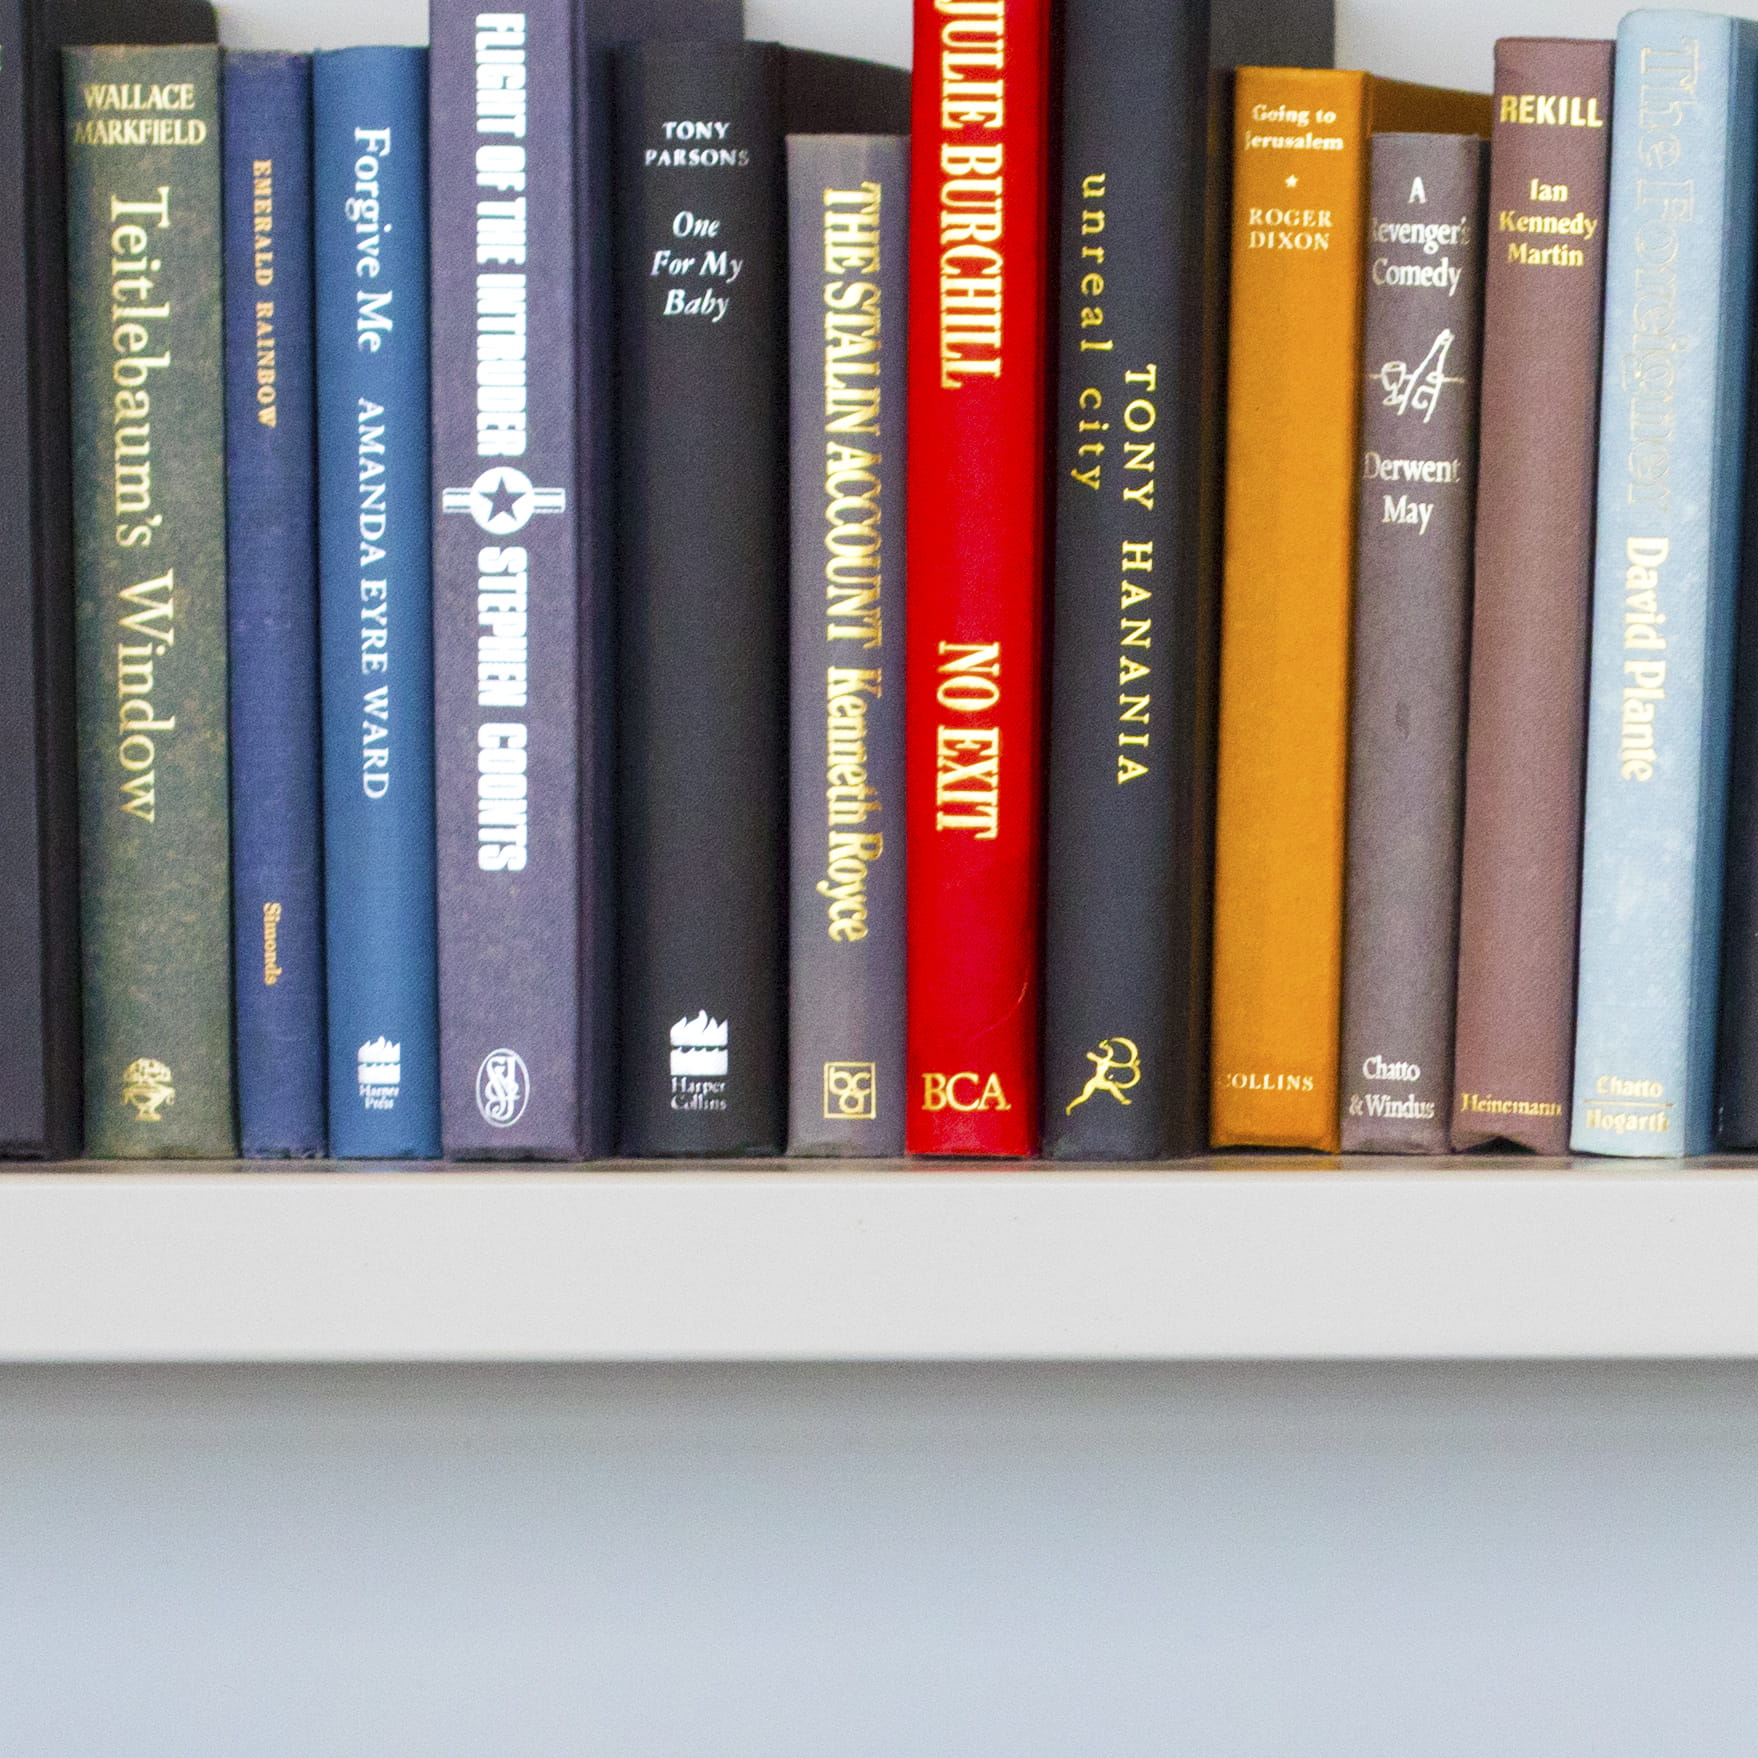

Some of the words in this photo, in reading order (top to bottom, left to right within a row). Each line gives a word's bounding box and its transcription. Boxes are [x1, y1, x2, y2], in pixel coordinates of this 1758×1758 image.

[75, 119, 206, 146] MARKFIELD
[83, 83, 195, 109] WALLACE
[663, 121, 730, 141] TONY
[1501, 94, 1603, 128] REKILL
[253, 160, 272, 287] EMERALD
[345, 127, 392, 279] Forgive
[673, 211, 719, 239] One
[1249, 209, 1333, 229] ROGER
[1500, 210, 1598, 239] Kennedy
[1530, 178, 1568, 203] Ian
[651, 250, 694, 277] For
[700, 252, 743, 283] My
[939, 143, 1006, 389] BURCHILL
[1080, 172, 1113, 352] unreal
[1249, 231, 1330, 250] DIXON
[1372, 258, 1462, 296] Comedy
[1508, 243, 1583, 267] Martin
[355, 290, 394, 353] Me
[663, 289, 730, 322] Baby
[109, 186, 171, 549] Teitlebaum's
[256, 301, 277, 428] RAINBOW
[1071, 387, 1110, 489] city
[1123, 364, 1158, 510] TONY
[355, 398, 387, 567] AMANDA
[1383, 496, 1433, 534] May
[360, 577, 388, 675] EYRE
[477, 546, 528, 707] STEPHEN
[1624, 536, 1669, 650] David
[116, 568, 175, 824] Window
[935, 640, 1000, 711] NO
[1117, 540, 1153, 784] HANANIA
[362, 686, 390, 800] WARD
[1620, 659, 1665, 783] Plante
[935, 725, 1000, 839] EXIT
[264, 902, 282, 985] Simonds
[922, 1071, 1010, 1112] BCA
